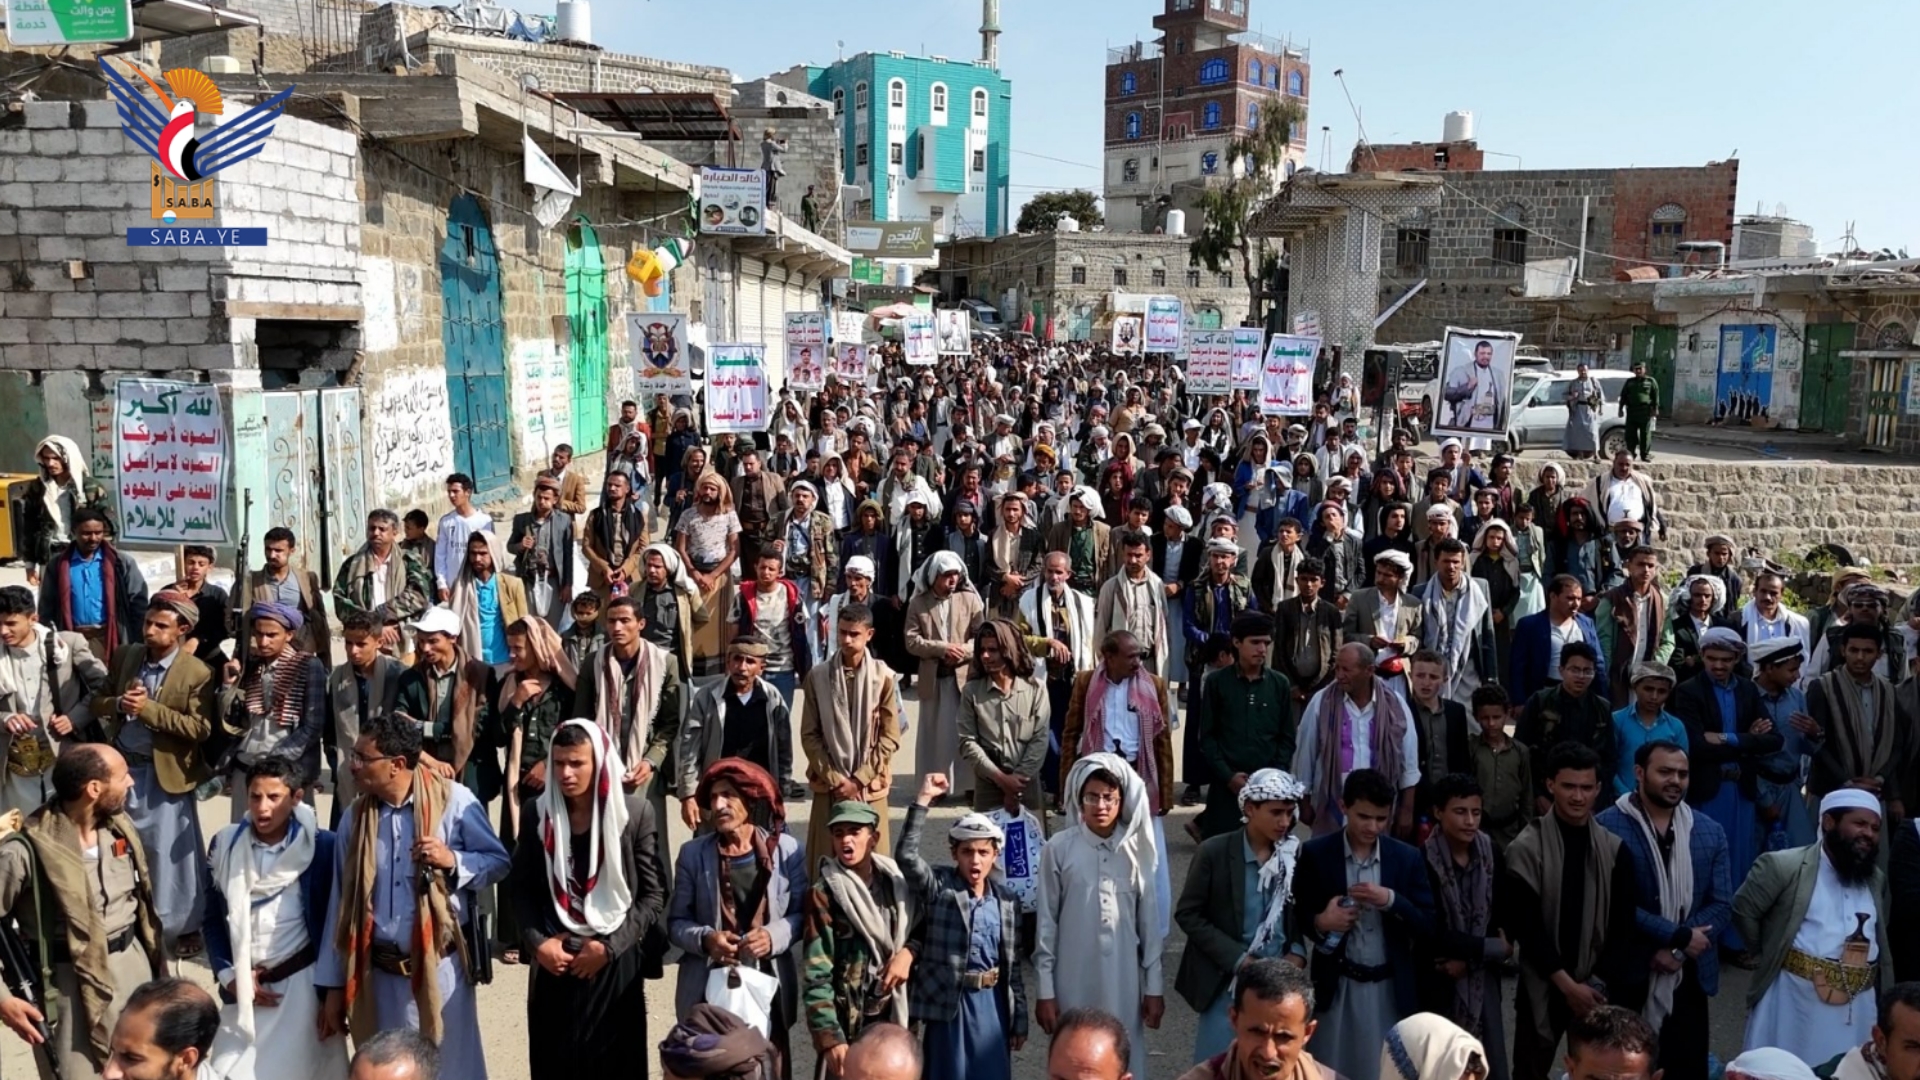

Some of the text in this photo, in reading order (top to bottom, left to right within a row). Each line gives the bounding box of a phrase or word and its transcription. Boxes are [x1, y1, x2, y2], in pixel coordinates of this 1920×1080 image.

[70, 5, 116, 18] يمن والت
[16, 17, 47, 29] خدمة
[887, 227, 921, 244] النجم
[1216, 334, 1232, 345] الله
[1271, 343, 1313, 359] قاطعوا
[122, 387, 219, 421] الله أكبر
[122, 423, 176, 446] لأمريكا
[179, 428, 221, 448] الموت
[123, 452, 219, 476] الموت لإسرائيل
[123, 480, 217, 501] اللعنة على اليهود
[126, 504, 218, 536] النصر للإسلام
